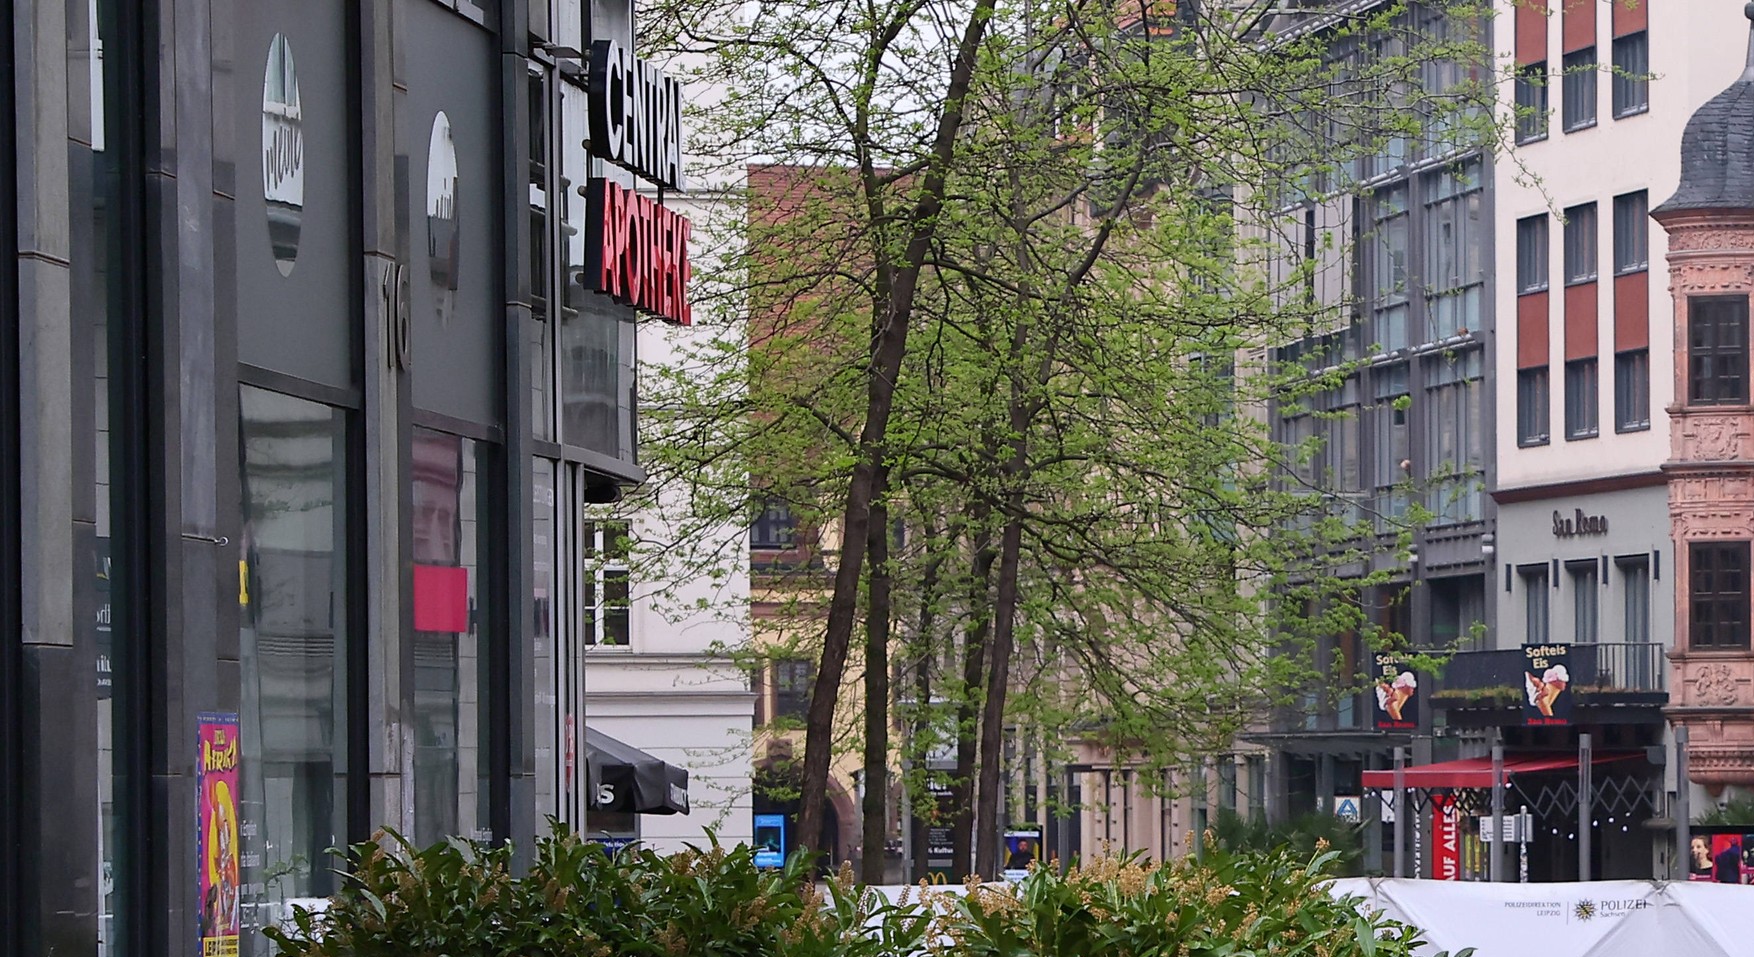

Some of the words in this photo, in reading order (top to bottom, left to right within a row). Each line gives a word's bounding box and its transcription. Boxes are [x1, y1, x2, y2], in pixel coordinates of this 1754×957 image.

[602, 177, 692, 326] APOTHEKE
[383, 258, 411, 372] 16
[1526, 644, 1567, 658] Softeis
[1533, 658, 1549, 669] Eis
[1443, 804, 1456, 851] ALLES
[1601, 898, 1647, 911] POLIZEI
